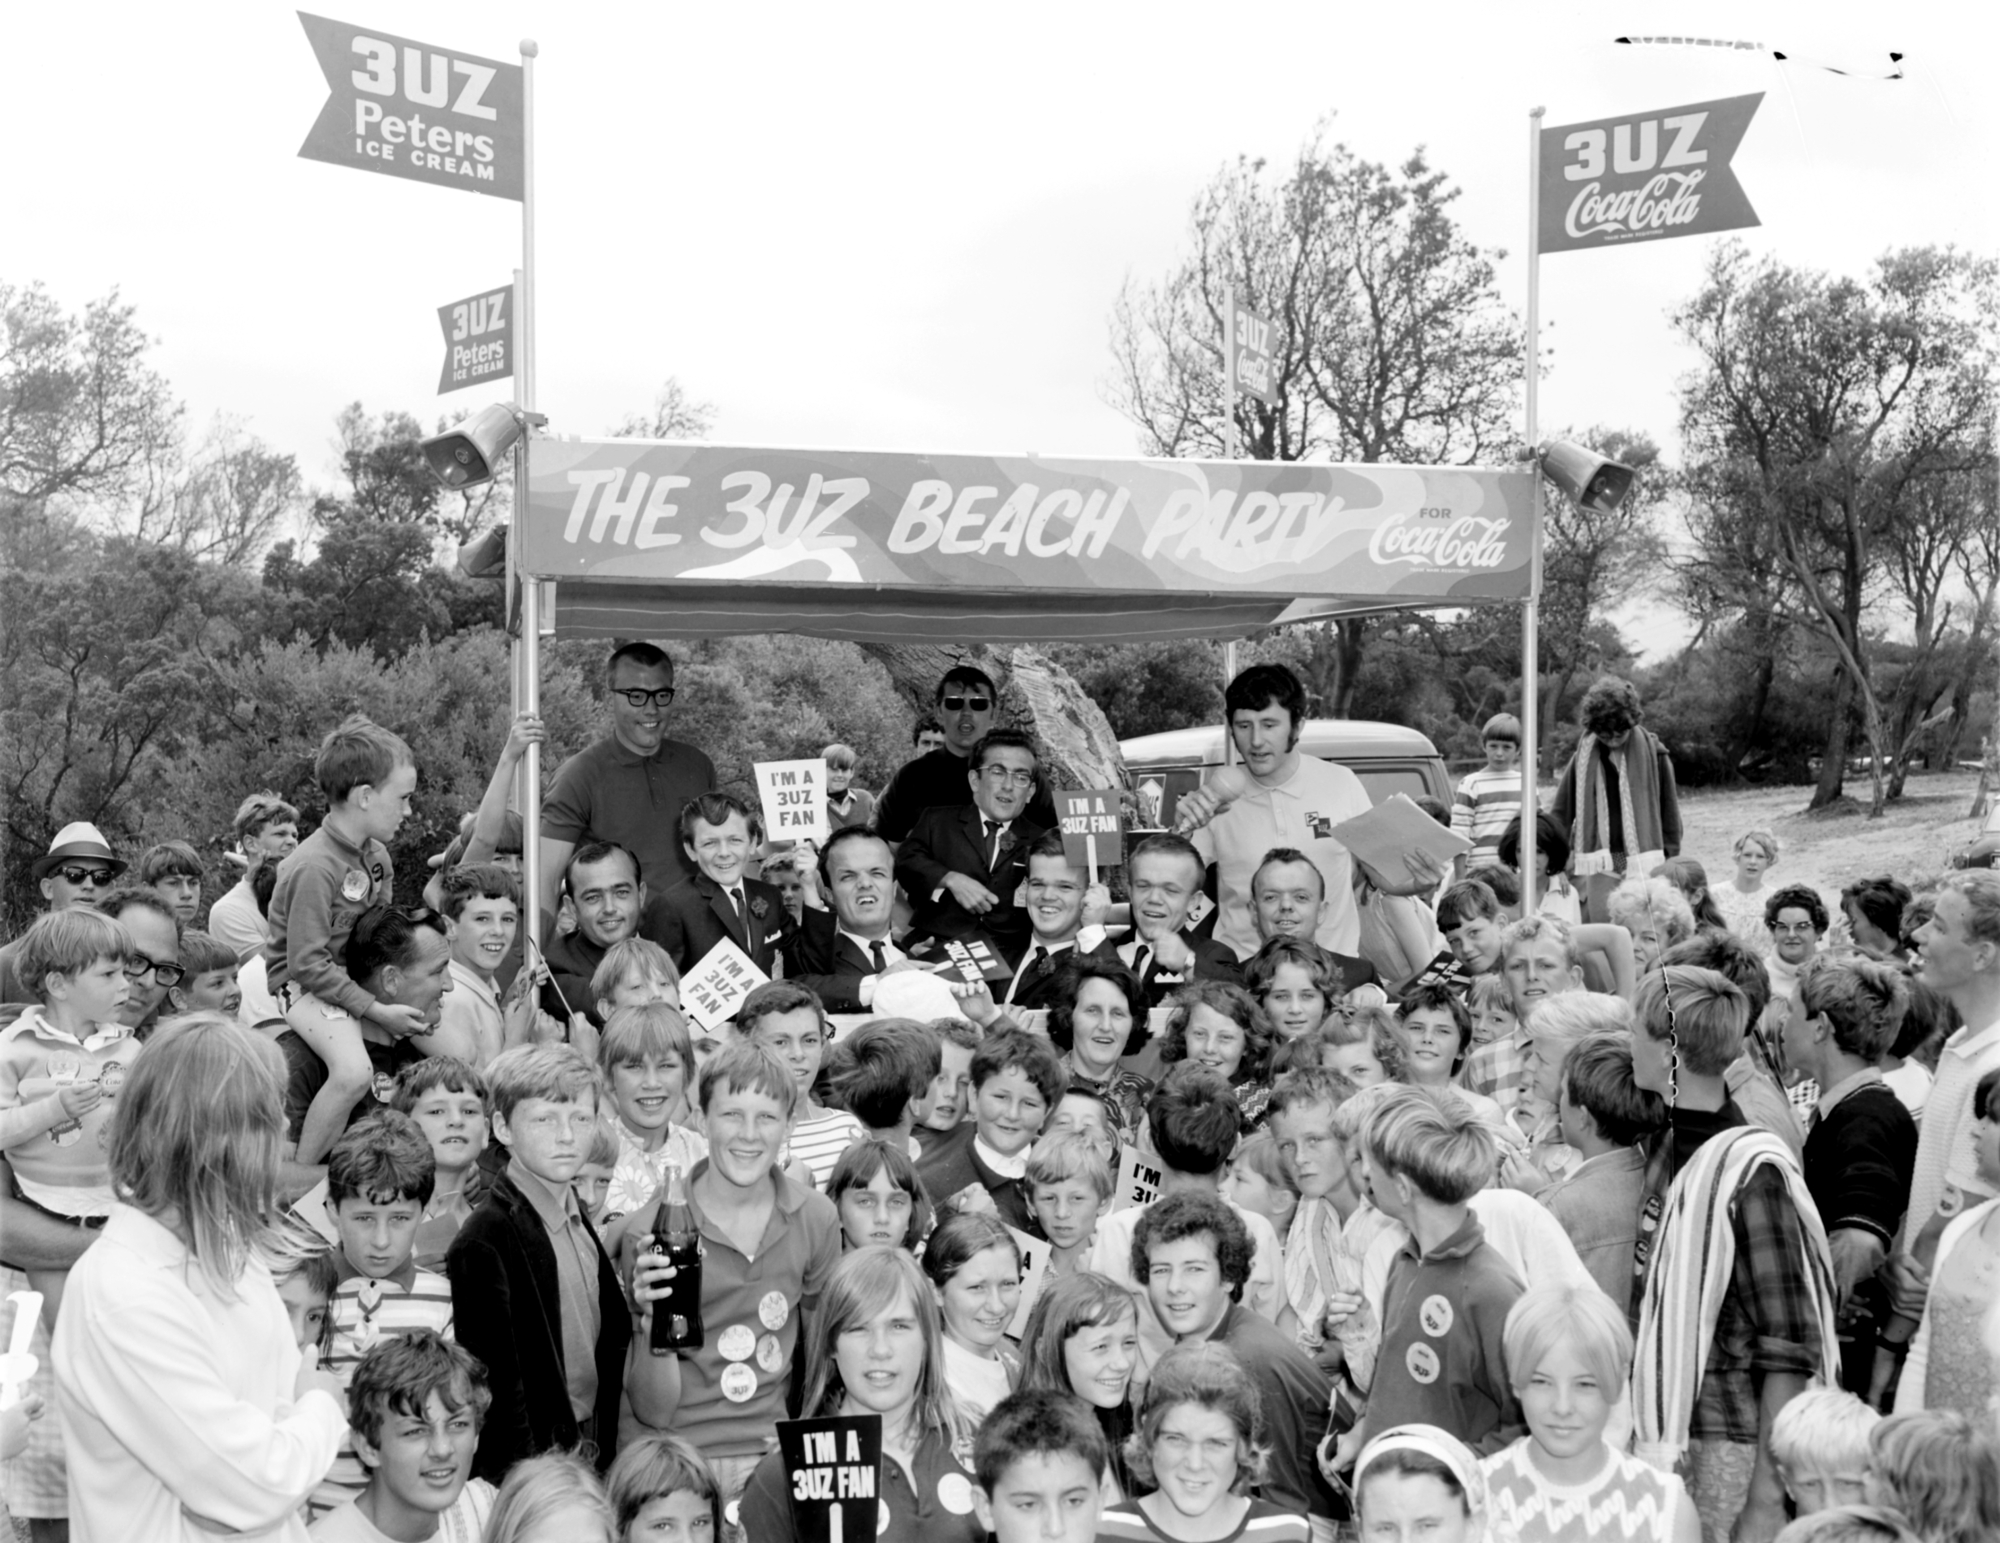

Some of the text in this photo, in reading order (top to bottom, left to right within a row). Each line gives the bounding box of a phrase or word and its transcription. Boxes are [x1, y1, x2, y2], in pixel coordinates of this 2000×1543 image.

[351, 35, 497, 121] 3UZ
[355, 98, 495, 162] Peters
[1563, 111, 1710, 181] 3UZ
[355, 138, 495, 181] ICE CREAM
[452, 292, 506, 341] 3UZ
[1236, 310, 1269, 358] 3UZ
[453, 340, 505, 370] Peters
[453, 359, 504, 381] ICE CREAM
[563, 467, 1345, 564] THE 3UZ BEACH PARTY
[1419, 508, 1452, 519] FOR
[771, 770, 814, 786] I'M A
[777, 790, 813, 806] 3UZ
[1068, 797, 1106, 815] I'M A
[779, 810, 815, 826] FAN
[1061, 815, 1118, 834] 3UZ FAN
[717, 953, 755, 992] I'M A
[943, 940, 985, 981] 3UZ FAN
[688, 982, 722, 1015] FAN
[704, 969, 739, 1003] 3UZ
[1133, 1163, 1161, 1187] I'M
[803, 1429, 861, 1464] I'M A
[792, 1465, 875, 1501] 3UZ FAN
